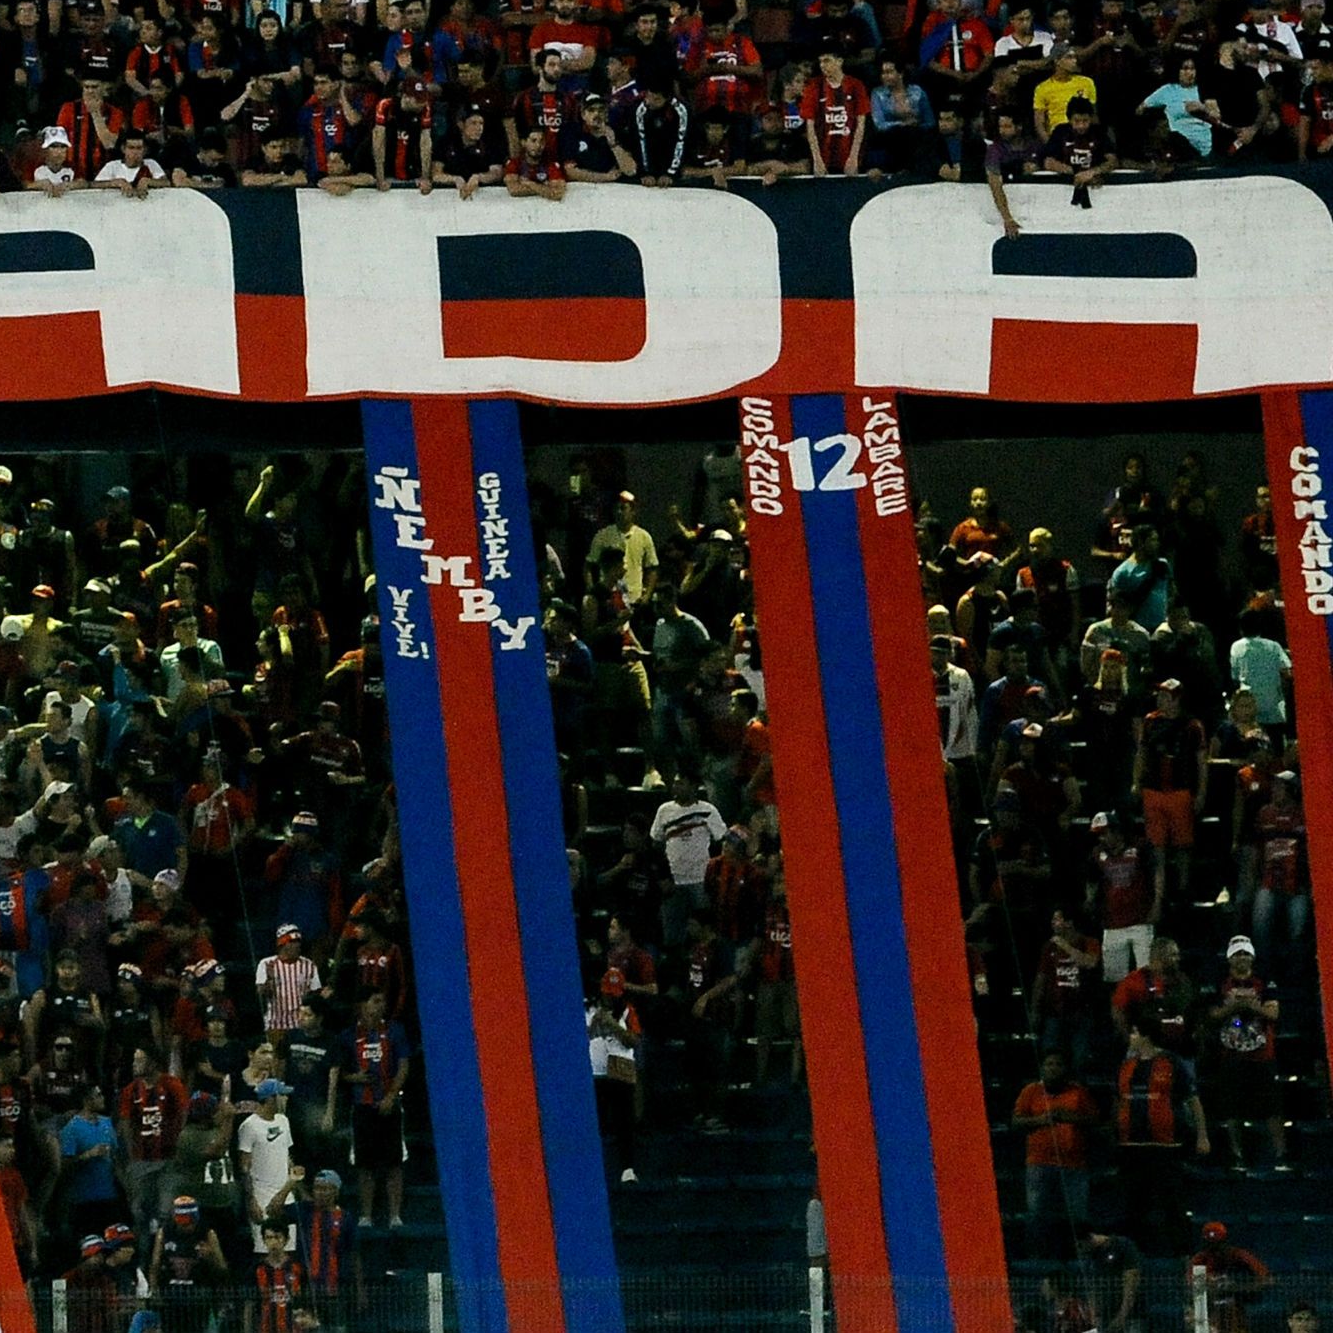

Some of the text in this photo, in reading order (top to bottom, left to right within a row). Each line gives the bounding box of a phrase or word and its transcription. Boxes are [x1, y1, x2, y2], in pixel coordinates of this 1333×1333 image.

[538, 113, 562, 132] tigo
[825, 111, 847, 127] tigo
[740, 396, 784, 516] COMANDO
[778, 433, 868, 492] 12
[862, 396, 908, 517] LAMBARE
[477, 472, 512, 581] GUINEA
[1289, 446, 1333, 615] COMANDO
[363, 682, 384, 698] tigo
[142, 1112, 162, 1128] tigo
